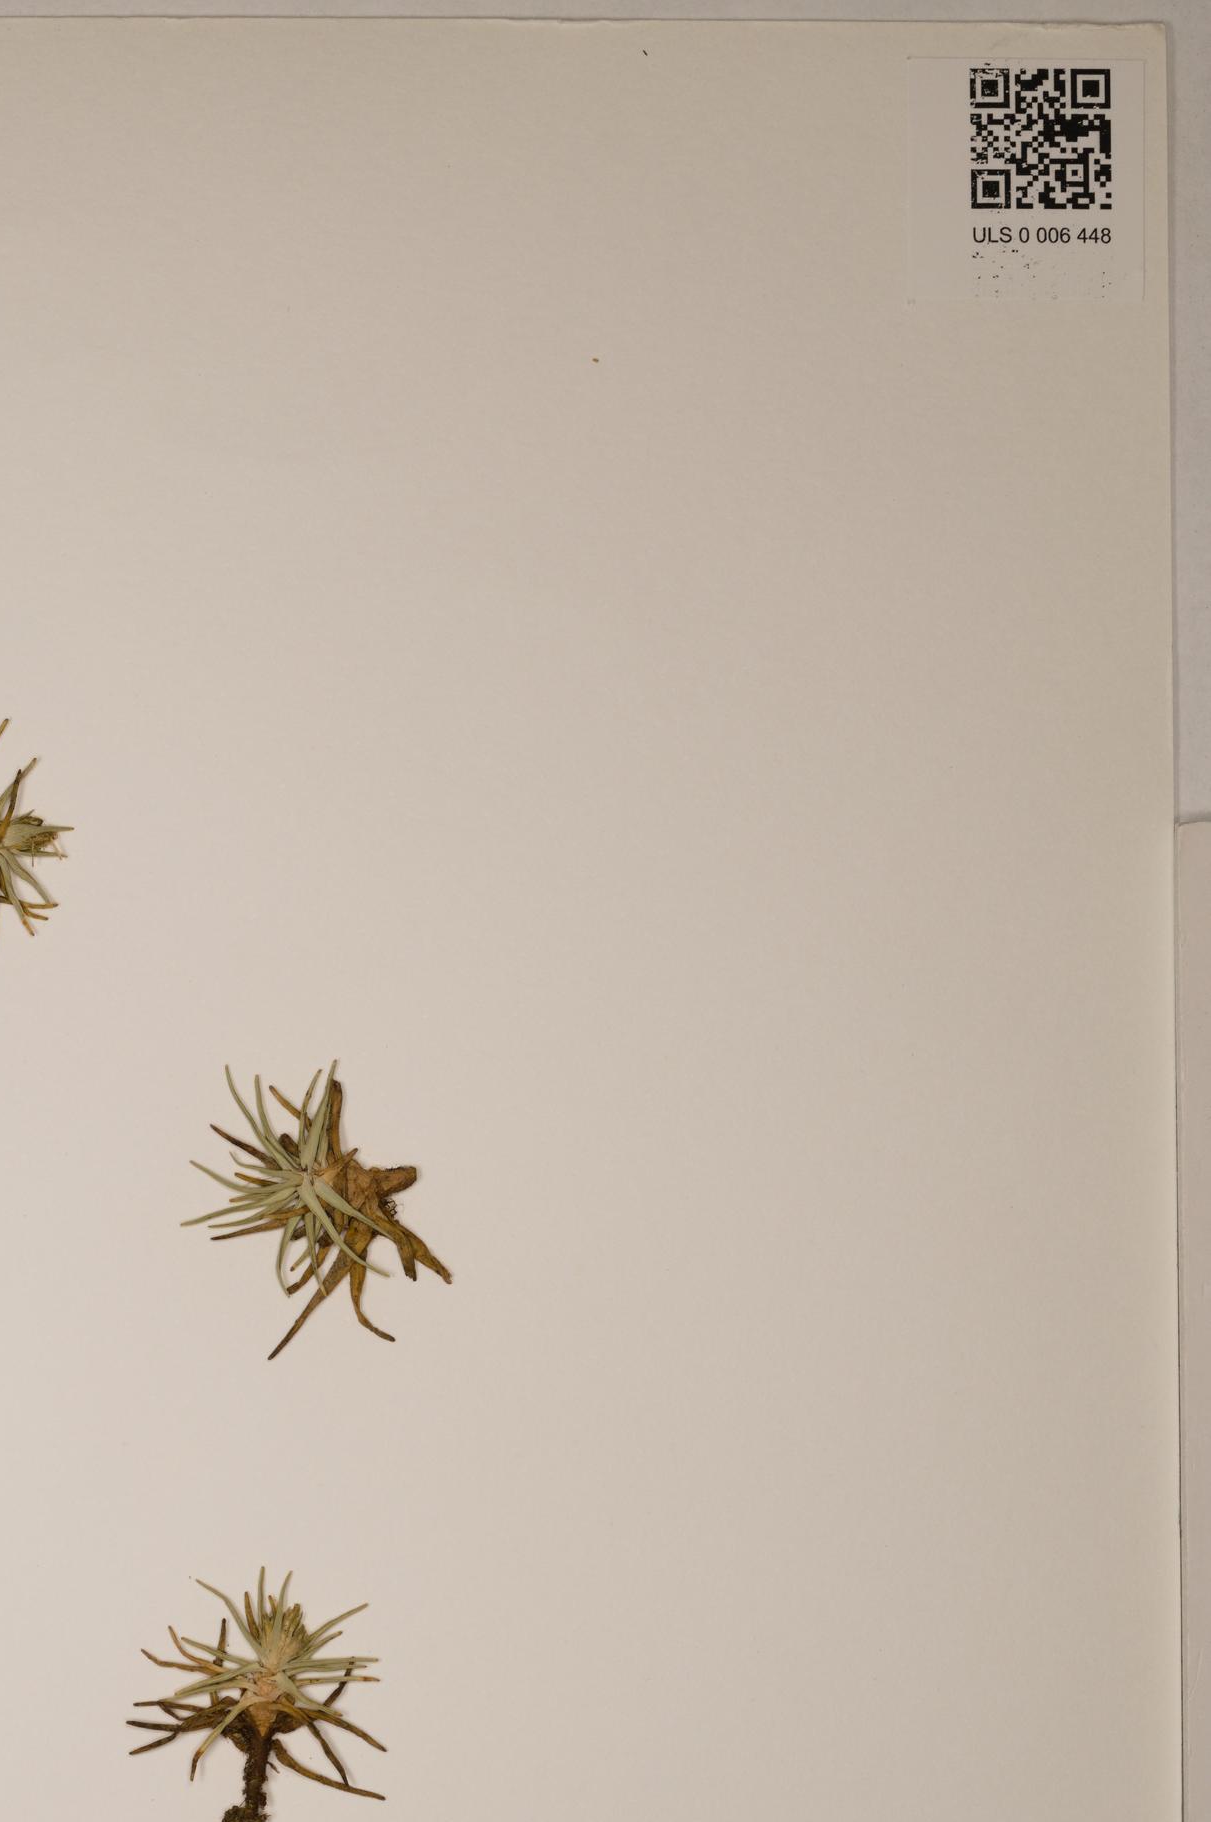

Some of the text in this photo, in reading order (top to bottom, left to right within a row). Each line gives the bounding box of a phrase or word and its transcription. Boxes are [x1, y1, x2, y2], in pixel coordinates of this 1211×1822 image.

[972, 226, 1112, 245] ULS 0 006 448
